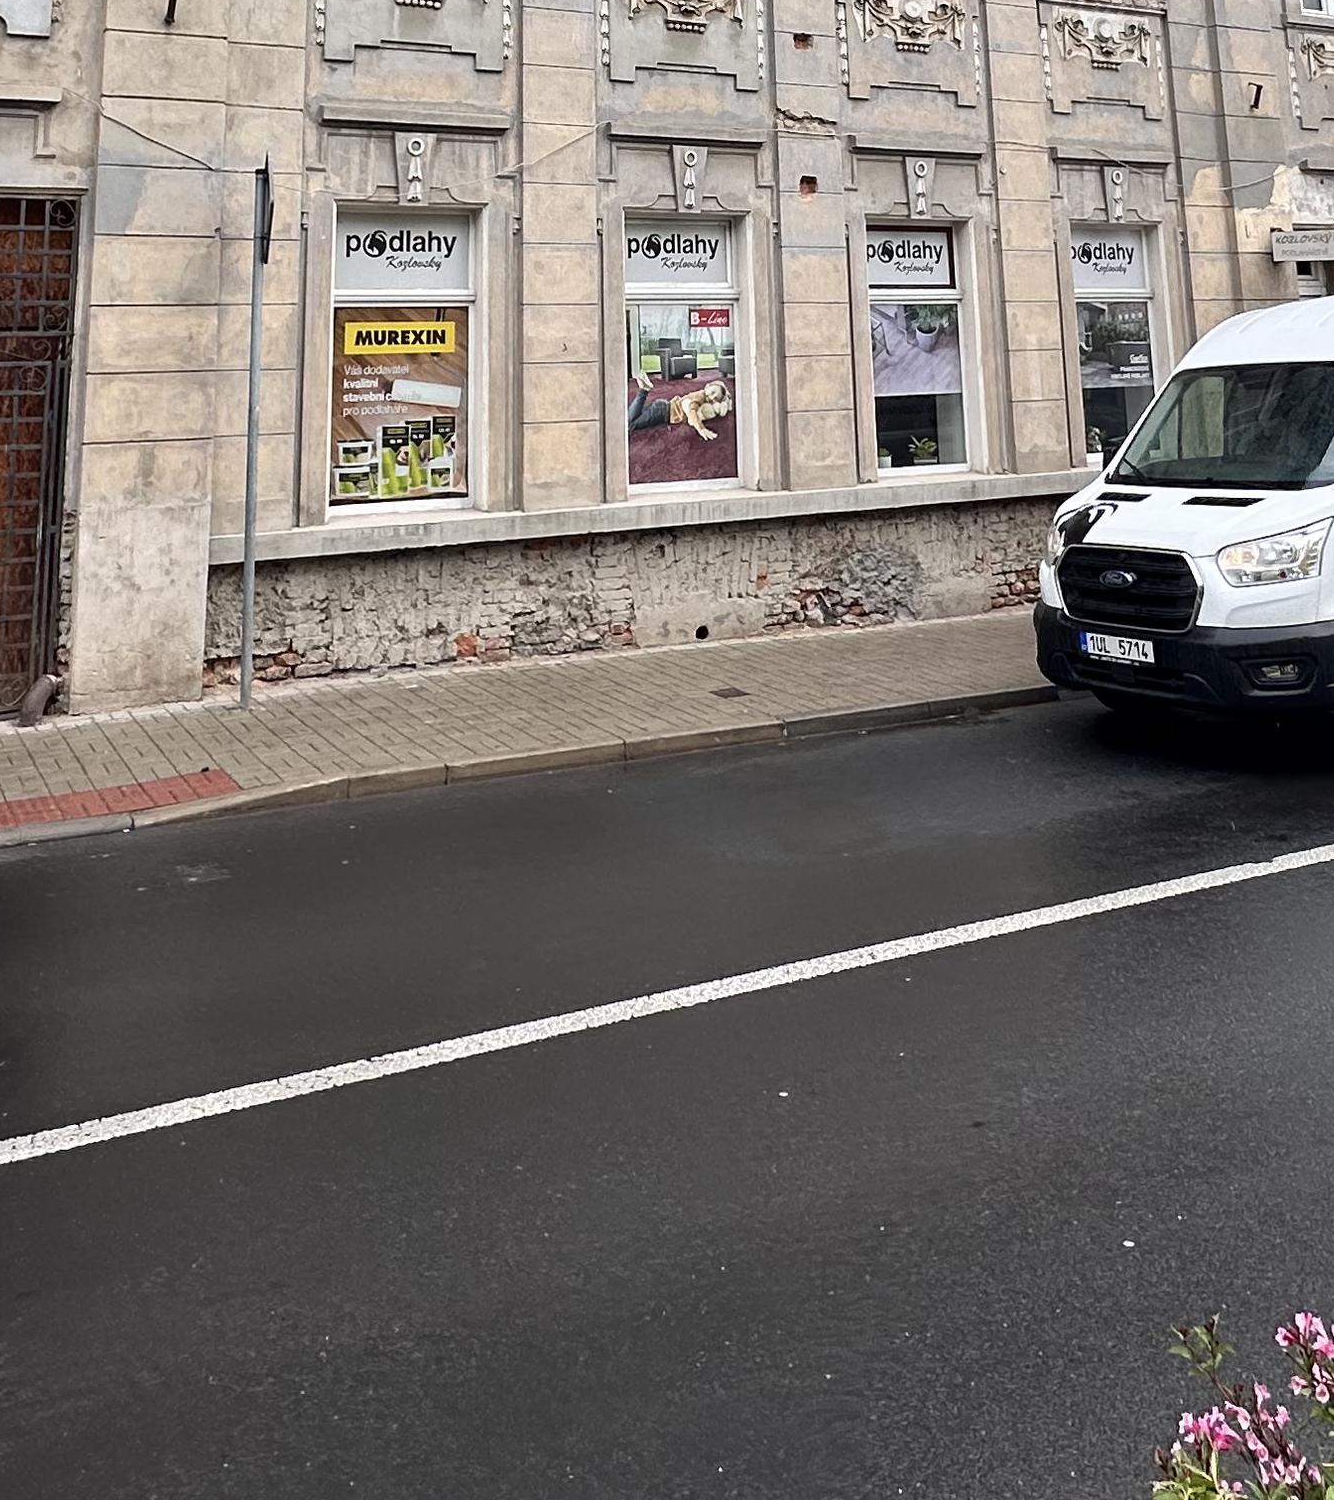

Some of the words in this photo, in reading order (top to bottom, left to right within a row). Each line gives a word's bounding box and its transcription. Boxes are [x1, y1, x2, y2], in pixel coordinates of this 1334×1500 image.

[345, 230, 457, 258] podlahy
[627, 233, 719, 260] podlahy
[355, 329, 446, 346] MUREXIN
[363, 363, 409, 376] dodavatel
[343, 378, 379, 389] kvalitní
[342, 391, 385, 403] stavební
[343, 407, 360, 418] pro
[1089, 635, 1111, 654] 1UL
[1118, 639, 1149, 660] 5714
